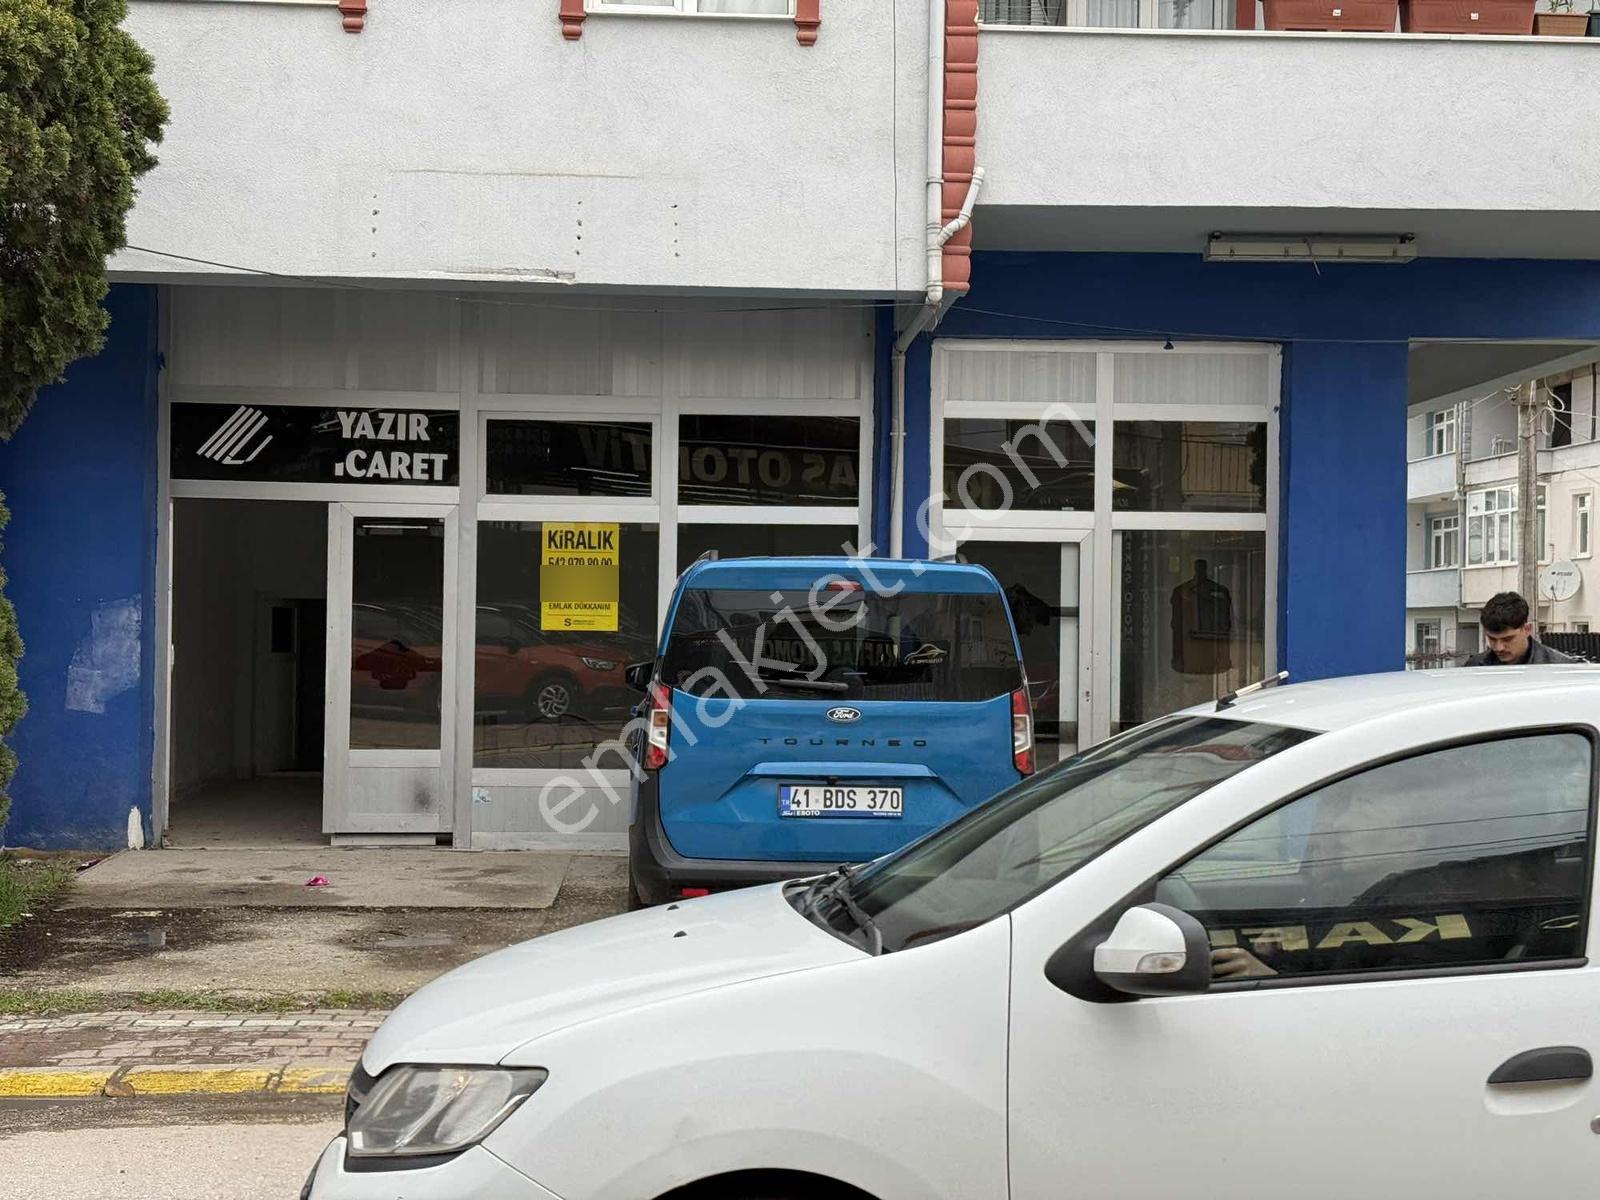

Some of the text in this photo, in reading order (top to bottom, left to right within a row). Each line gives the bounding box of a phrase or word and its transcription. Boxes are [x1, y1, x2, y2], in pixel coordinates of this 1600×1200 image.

[337, 411, 430, 441] YAZIR
[548, 602, 573, 610] EMLAK
[833, 708, 855, 720] Ford
[757, 738, 928, 747] TOURNEO
[791, 788, 810, 808] 41
[823, 789, 857, 809] BDS
[867, 790, 900, 810] 370
